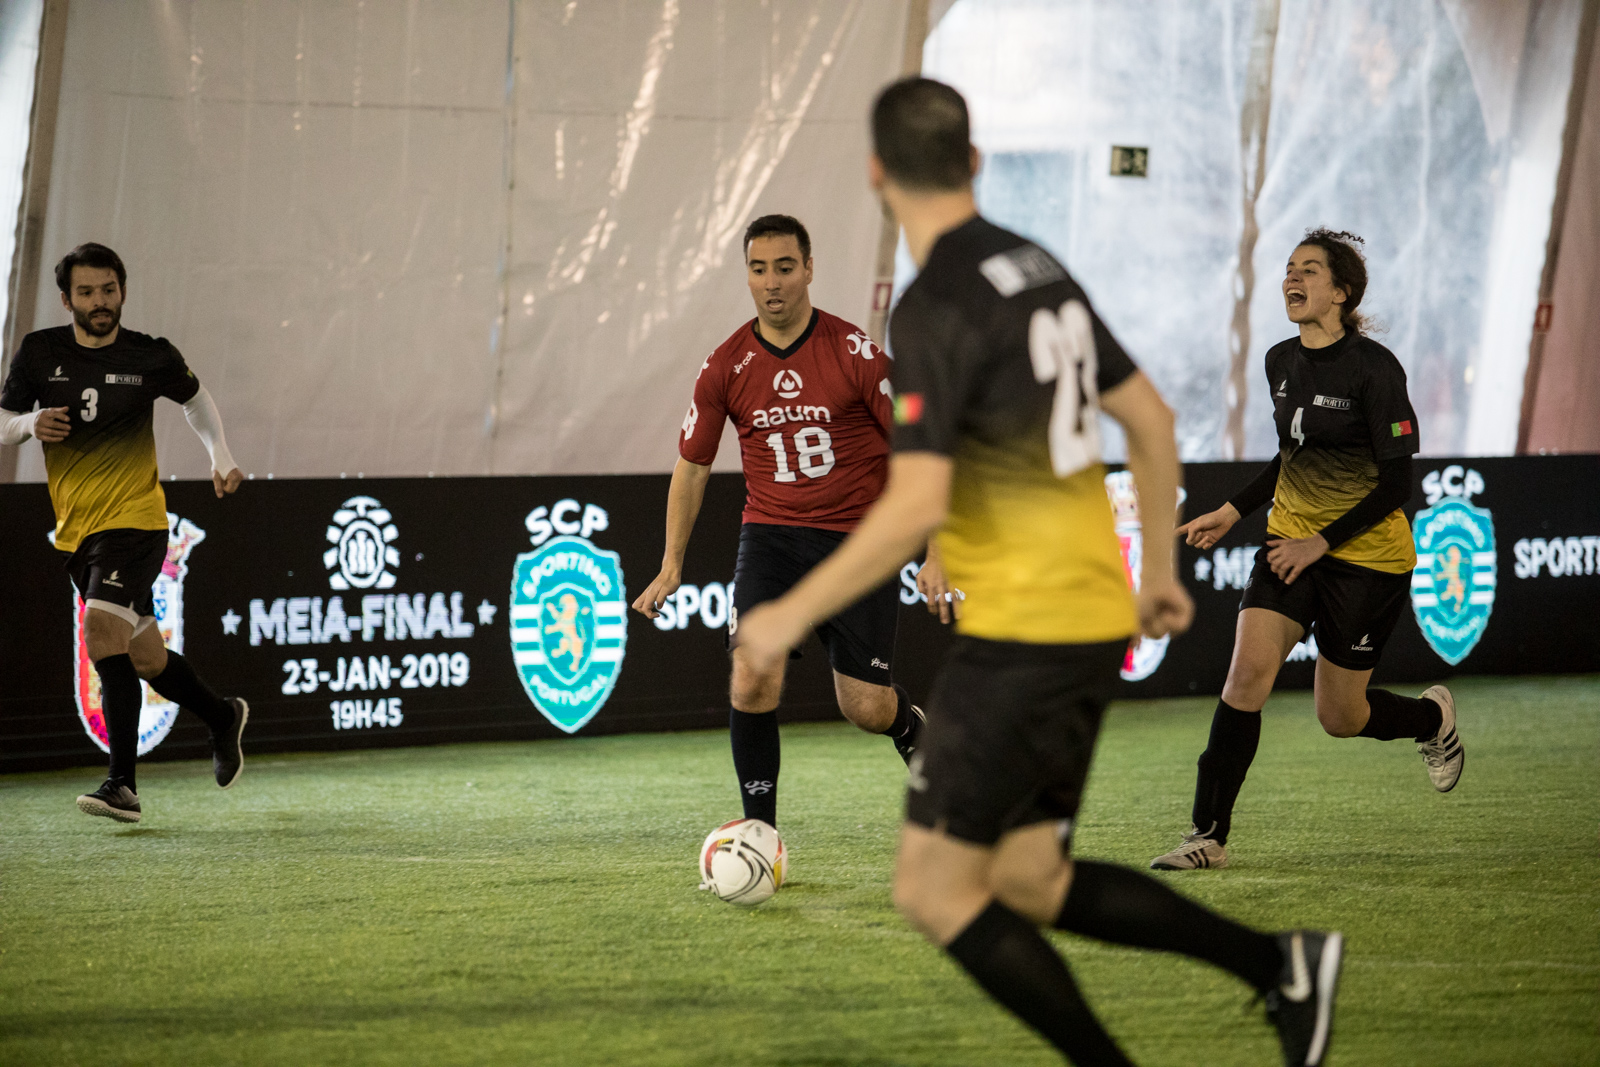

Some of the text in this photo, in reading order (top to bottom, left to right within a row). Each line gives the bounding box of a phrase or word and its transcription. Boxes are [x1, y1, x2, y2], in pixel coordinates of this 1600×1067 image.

[80, 387, 99, 422] 3
[752, 404, 832, 429] aaum
[1290, 406, 1305, 446] 4
[765, 426, 836, 483] 18
[1421, 464, 1485, 506] SCP
[524, 497, 609, 546] SCP
[249, 591, 475, 647] MEIA-FINAL
[281, 651, 471, 695] 23-JAN-2019
[329, 696, 404, 731] 19H45
